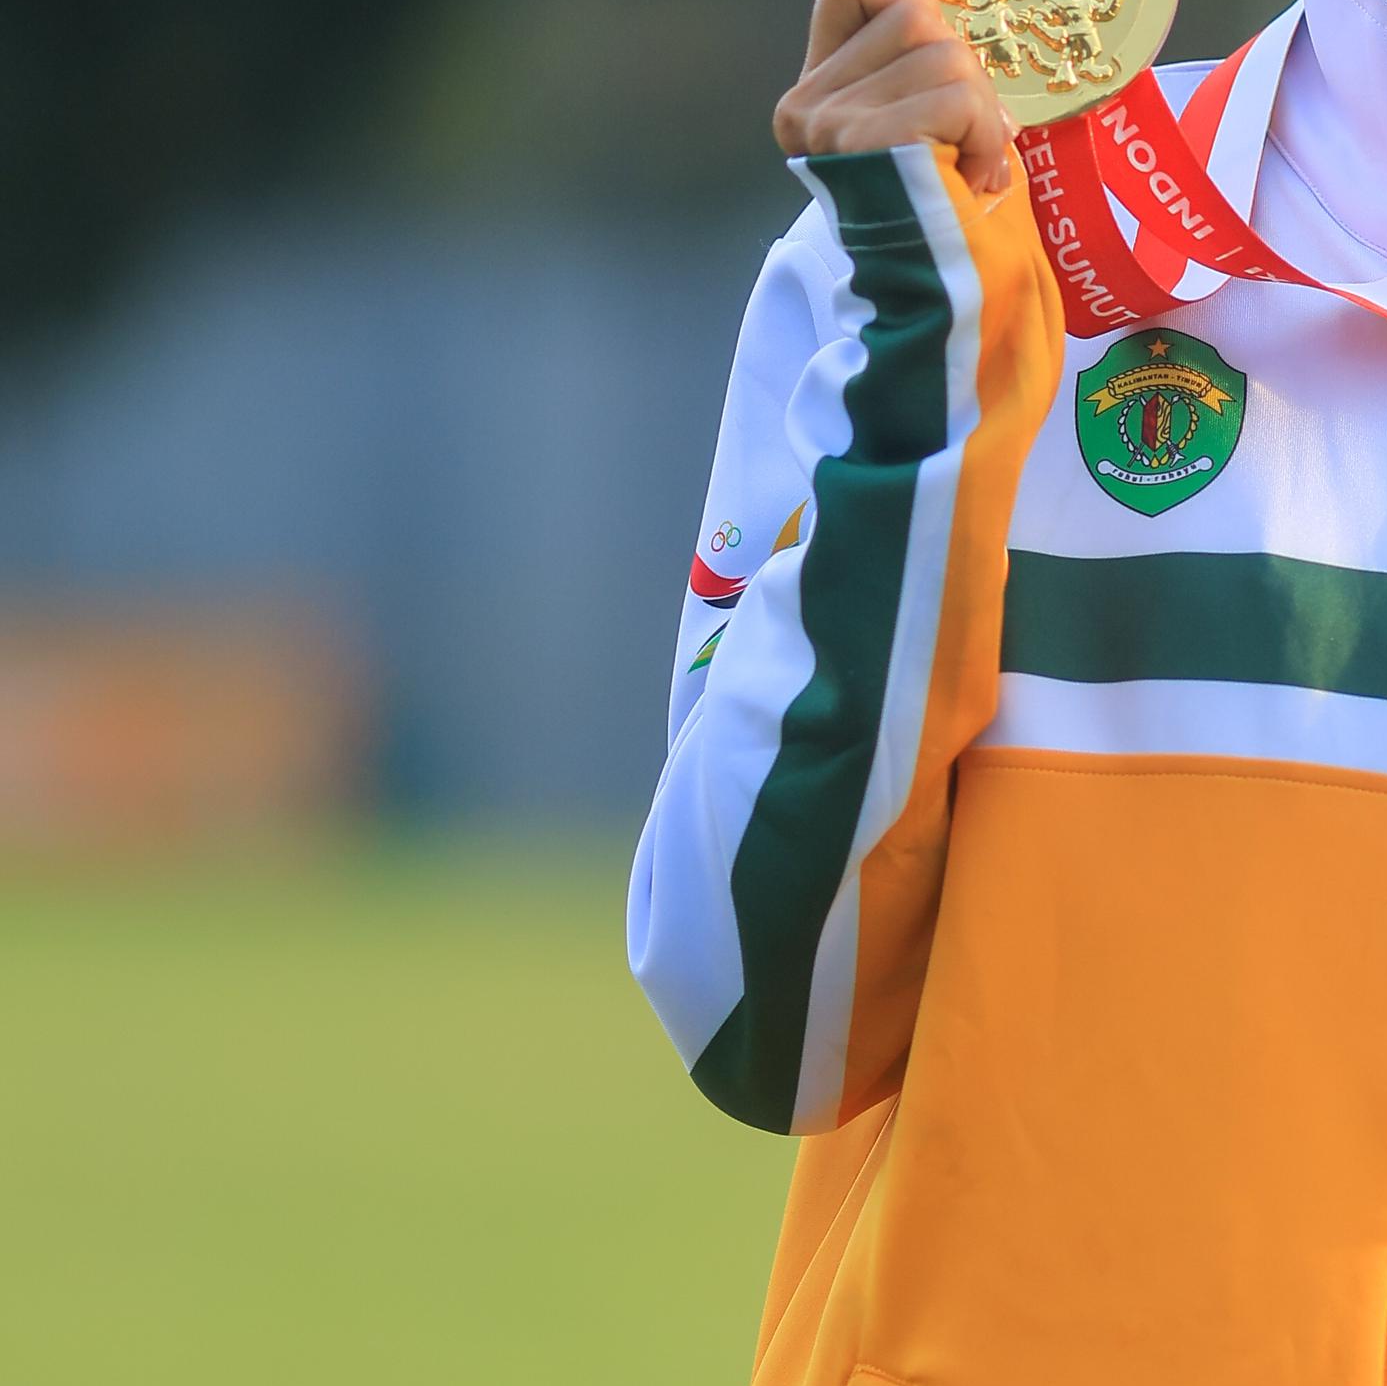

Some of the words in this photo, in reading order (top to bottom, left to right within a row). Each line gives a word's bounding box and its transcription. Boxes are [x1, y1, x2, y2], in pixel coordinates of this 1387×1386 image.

[1096, 98, 1216, 240] INDON
[1117, 373, 1169, 389] KALIMANTAN
[1176, 375, 1203, 388] TIMUR
